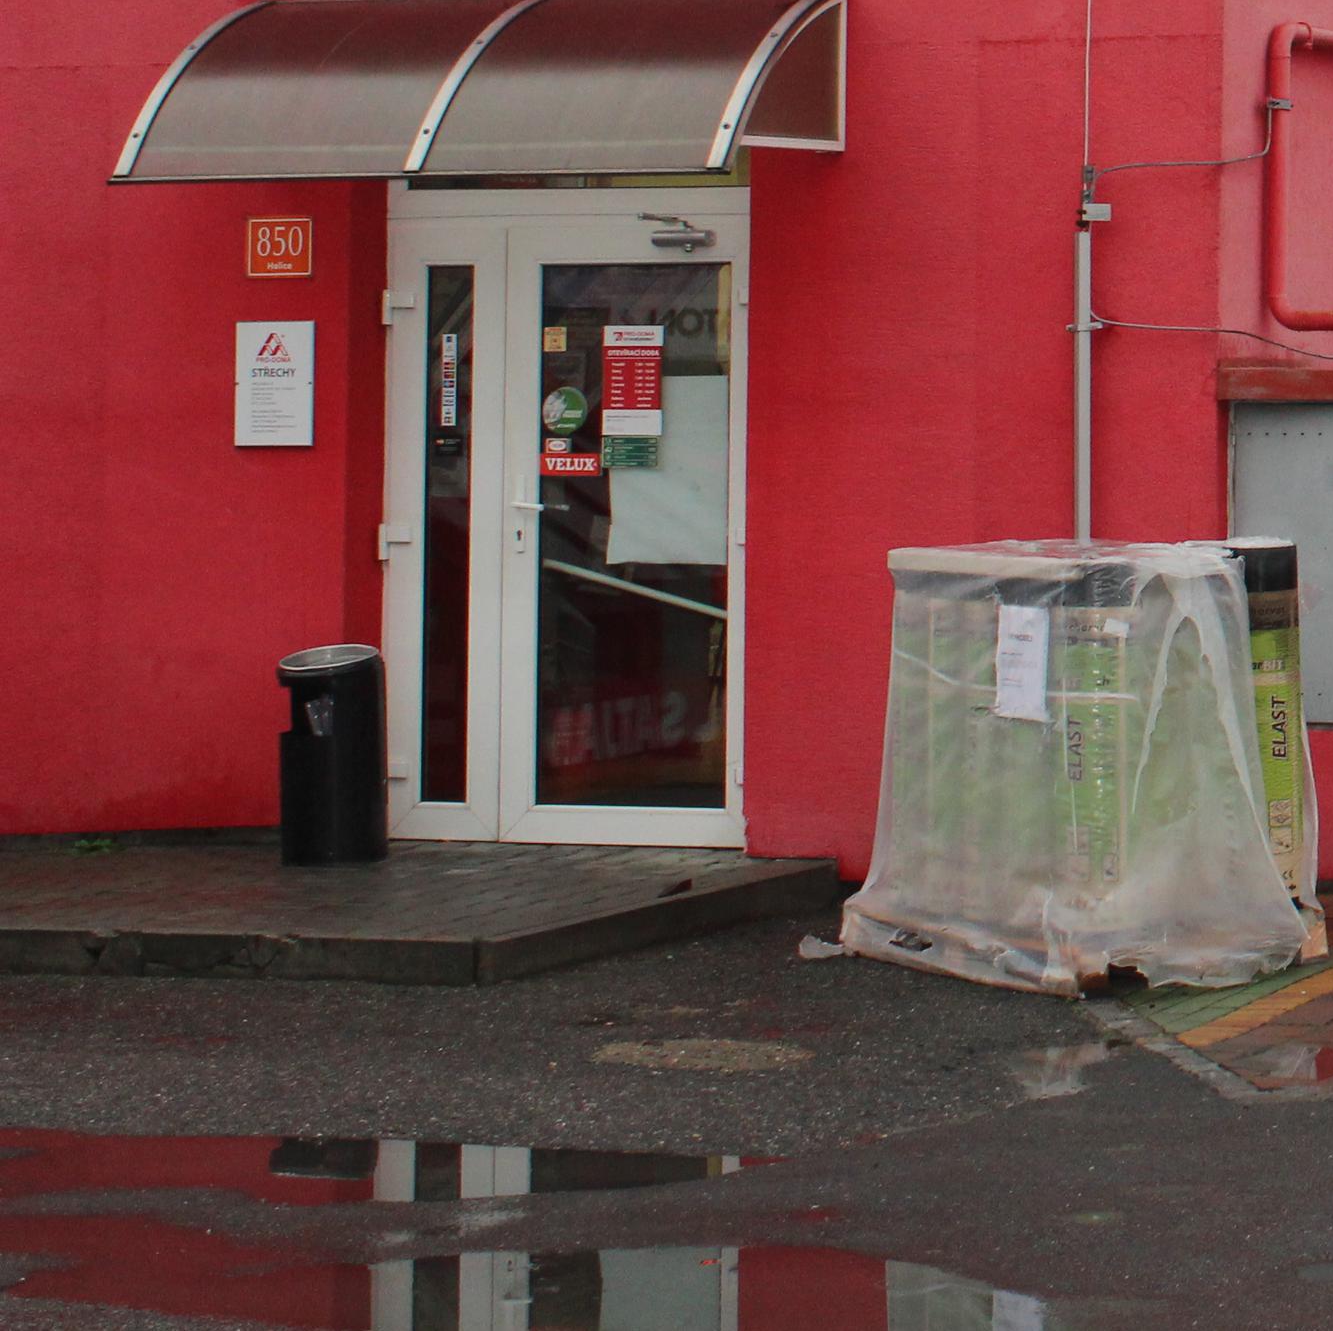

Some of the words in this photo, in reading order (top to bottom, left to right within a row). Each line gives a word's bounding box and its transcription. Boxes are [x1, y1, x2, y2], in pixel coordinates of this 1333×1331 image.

[257, 226, 303, 256] 850
[251, 367, 297, 379] STŘECHY
[545, 457, 596, 471] VELUX
[1271, 695, 1288, 760] ELAST
[1067, 717, 1084, 782] ELAST
